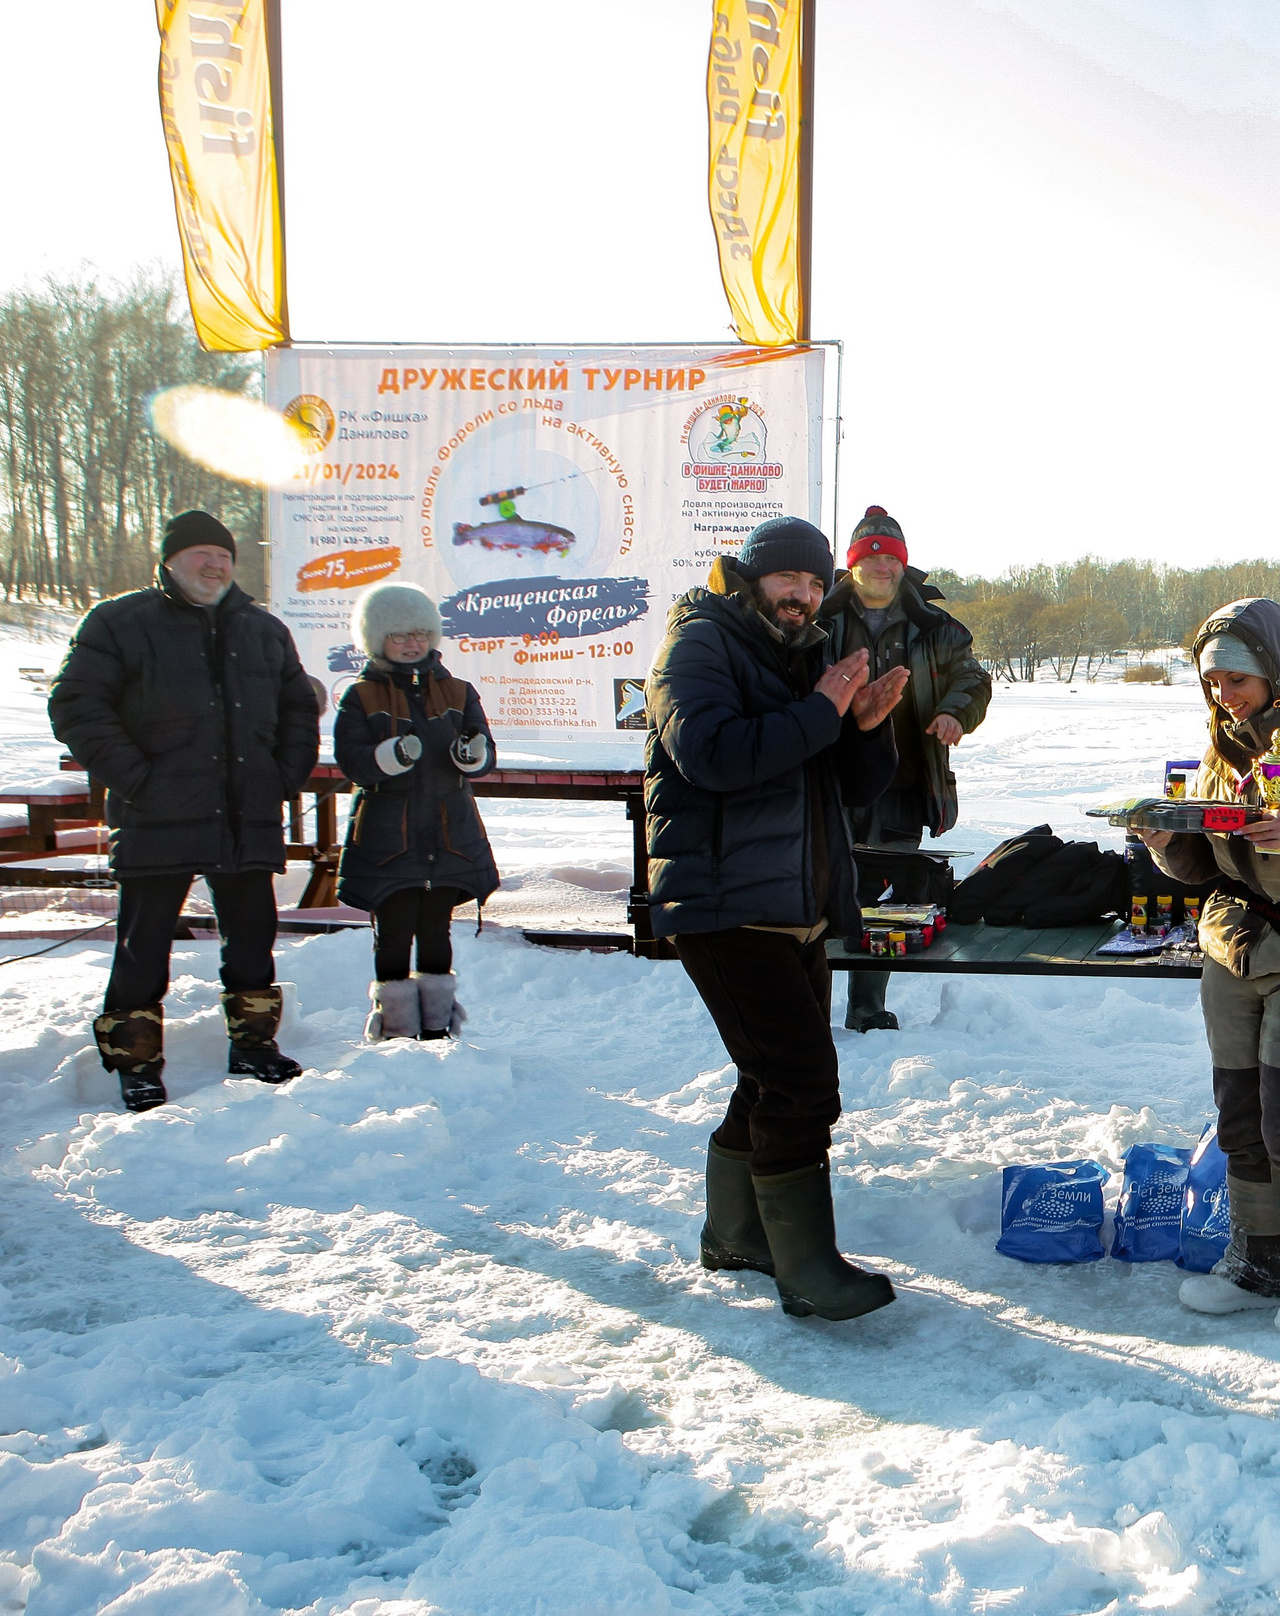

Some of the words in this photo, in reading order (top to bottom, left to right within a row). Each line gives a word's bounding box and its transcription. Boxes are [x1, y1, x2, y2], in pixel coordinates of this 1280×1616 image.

[377, 360, 569, 395] ДРУЖЕСКИЙ
[581, 368, 706, 391] ТУРНИР
[498, 402, 518, 415] со
[522, 396, 564, 412] льда
[339, 410, 358, 422] РК
[361, 409, 429, 423] «Фишка»
[337, 427, 409, 441] Данилово
[438, 409, 495, 462] Форели
[684, 465, 691, 476] В
[693, 464, 781, 477] ФИШКЕ-ДАНИЛОВО
[542, 415, 562, 429] на
[566, 421, 628, 490] активную
[620, 494, 634, 556] снасть
[699, 479, 728, 490] БУДЕТ
[731, 479, 765, 490] ЖАРКО!
[421, 466, 442, 521] ловле
[682, 500, 712, 508] Ловля
[715, 501, 783, 510] производится
[702, 510, 748, 519] активную
[751, 510, 784, 518] снасть
[421, 525, 434, 548] по
[694, 549, 722, 558] кубок
[326, 558, 345, 578] 75
[672, 558, 693, 567] 50%
[695, 560, 706, 568] от
[329, 597, 336, 605] 5
[456, 583, 598, 615] «Крещенская
[547, 603, 639, 628] Форель»
[458, 638, 505, 654] Старт
[513, 648, 574, 666] Финиш
[588, 641, 634, 659] 12:00
[500, 675, 574, 686] Домодедовский
[519, 687, 565, 696] Данилово
[499, 697, 505, 705] 8
[507, 697, 537, 706] (9104)
[540, 697, 577, 706] 333-222
[507, 707, 533, 717] (800)
[536, 708, 578, 716] 333-19-14
[1050, 1188, 1091, 1203] Земли
